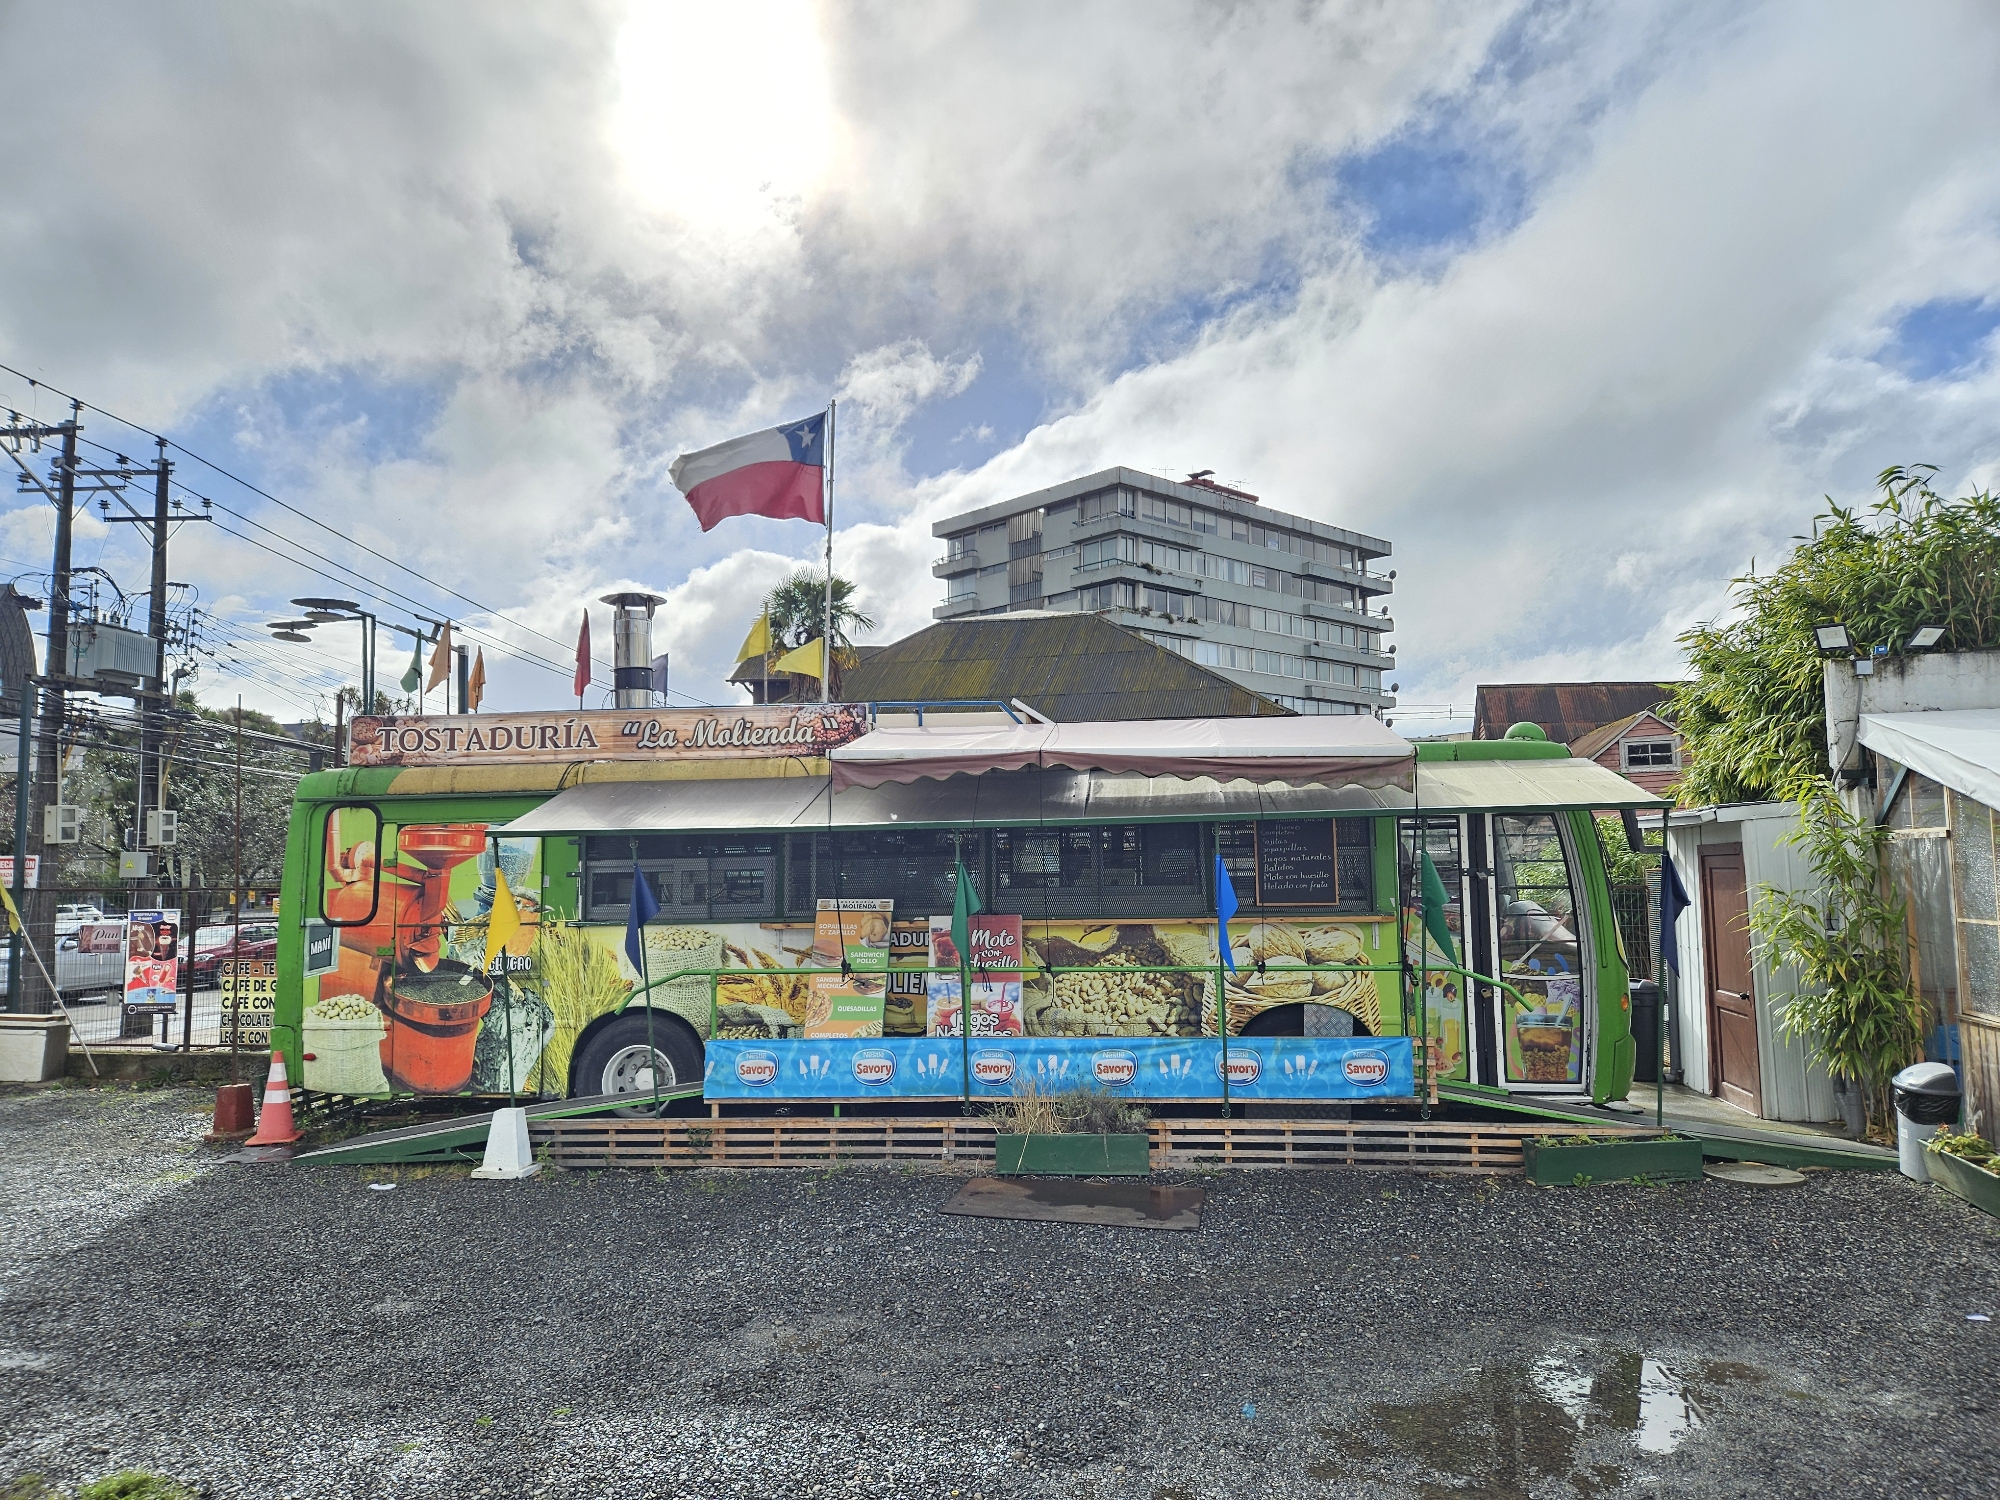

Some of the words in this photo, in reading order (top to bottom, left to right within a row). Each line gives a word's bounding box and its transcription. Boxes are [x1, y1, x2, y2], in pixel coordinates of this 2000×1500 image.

[376, 719, 598, 752] TOSTADURÍA
[1263, 854, 1287, 864] Jugos
[1291, 853, 1332, 862] naturales
[1264, 863, 1294, 872] Batidos
[1300, 871, 1330, 879] huesillo
[1264, 881, 1294, 890] Helado
[93, 928, 120, 941] Pan
[971, 929, 1017, 949] Mote
[310, 934, 331, 955] MANÍ
[254, 980, 266, 992] DE
[253, 997, 275, 1010] CON
[248, 1031, 268, 1044] CON
[739, 1064, 774, 1077] Savory
[856, 1063, 892, 1076] Savory
[975, 1063, 1011, 1076] Savory
[1096, 1063, 1133, 1076] Savory
[1219, 1063, 1258, 1076] Savory
[1346, 1063, 1385, 1076] Savory
